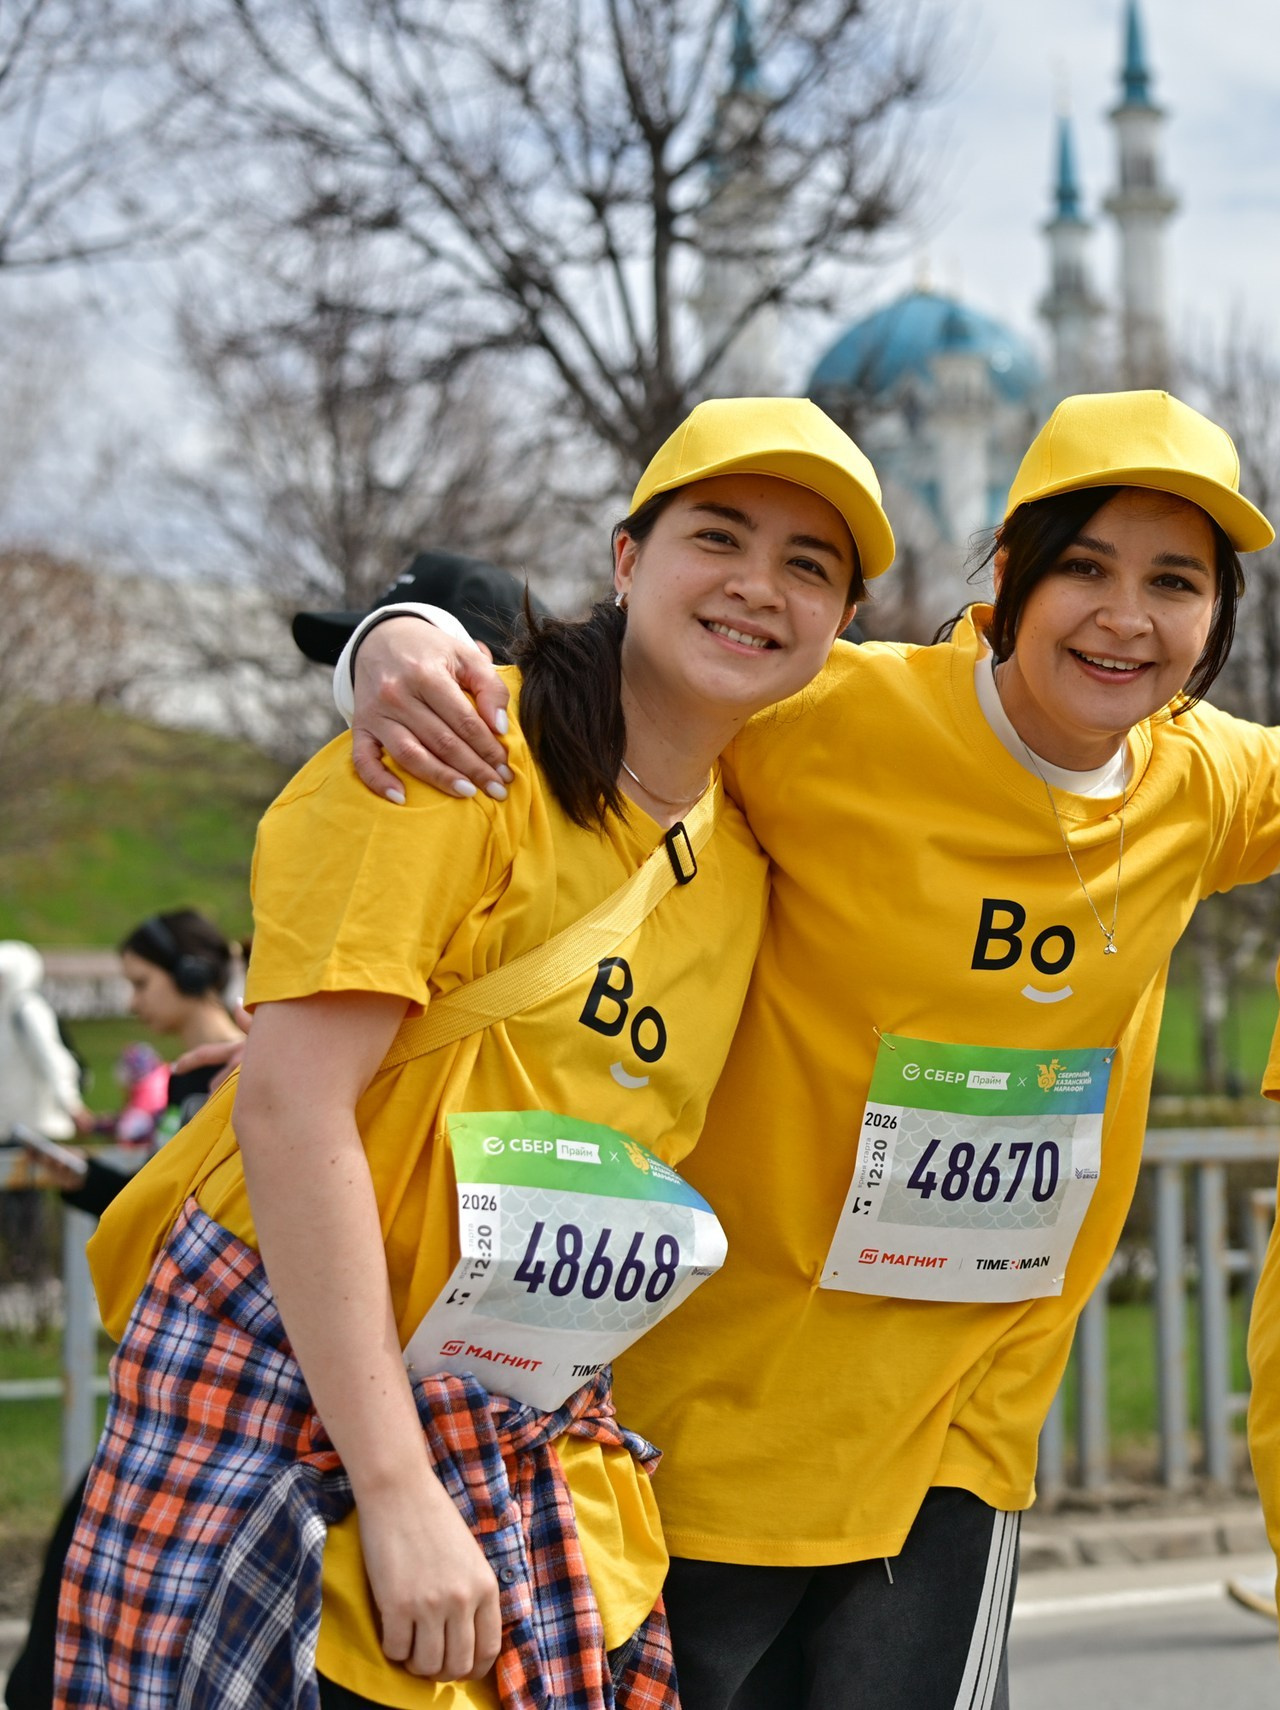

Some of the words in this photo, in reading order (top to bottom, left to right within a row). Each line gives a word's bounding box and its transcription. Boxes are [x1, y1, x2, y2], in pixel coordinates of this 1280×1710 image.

[924, 1069, 966, 1084] СБЕР
[972, 1074, 1002, 1085] Прайм
[1056, 1077, 1092, 1085] КАЗАНСКИЙ
[864, 1112, 898, 1129] 2026
[509, 1138, 554, 1154] СБЕР
[561, 1145, 593, 1157] Прайм
[867, 1139, 888, 1188] 12:20
[906, 1139, 1059, 1203] 48670
[462, 1194, 497, 1212] 2026
[470, 1225, 492, 1279] 12:20
[881, 1253, 948, 1268] МАГНИТ
[514, 1222, 680, 1302] 48668
[465, 1345, 543, 1371] МАГНИТ
[571, 1364, 603, 1377] TIME
